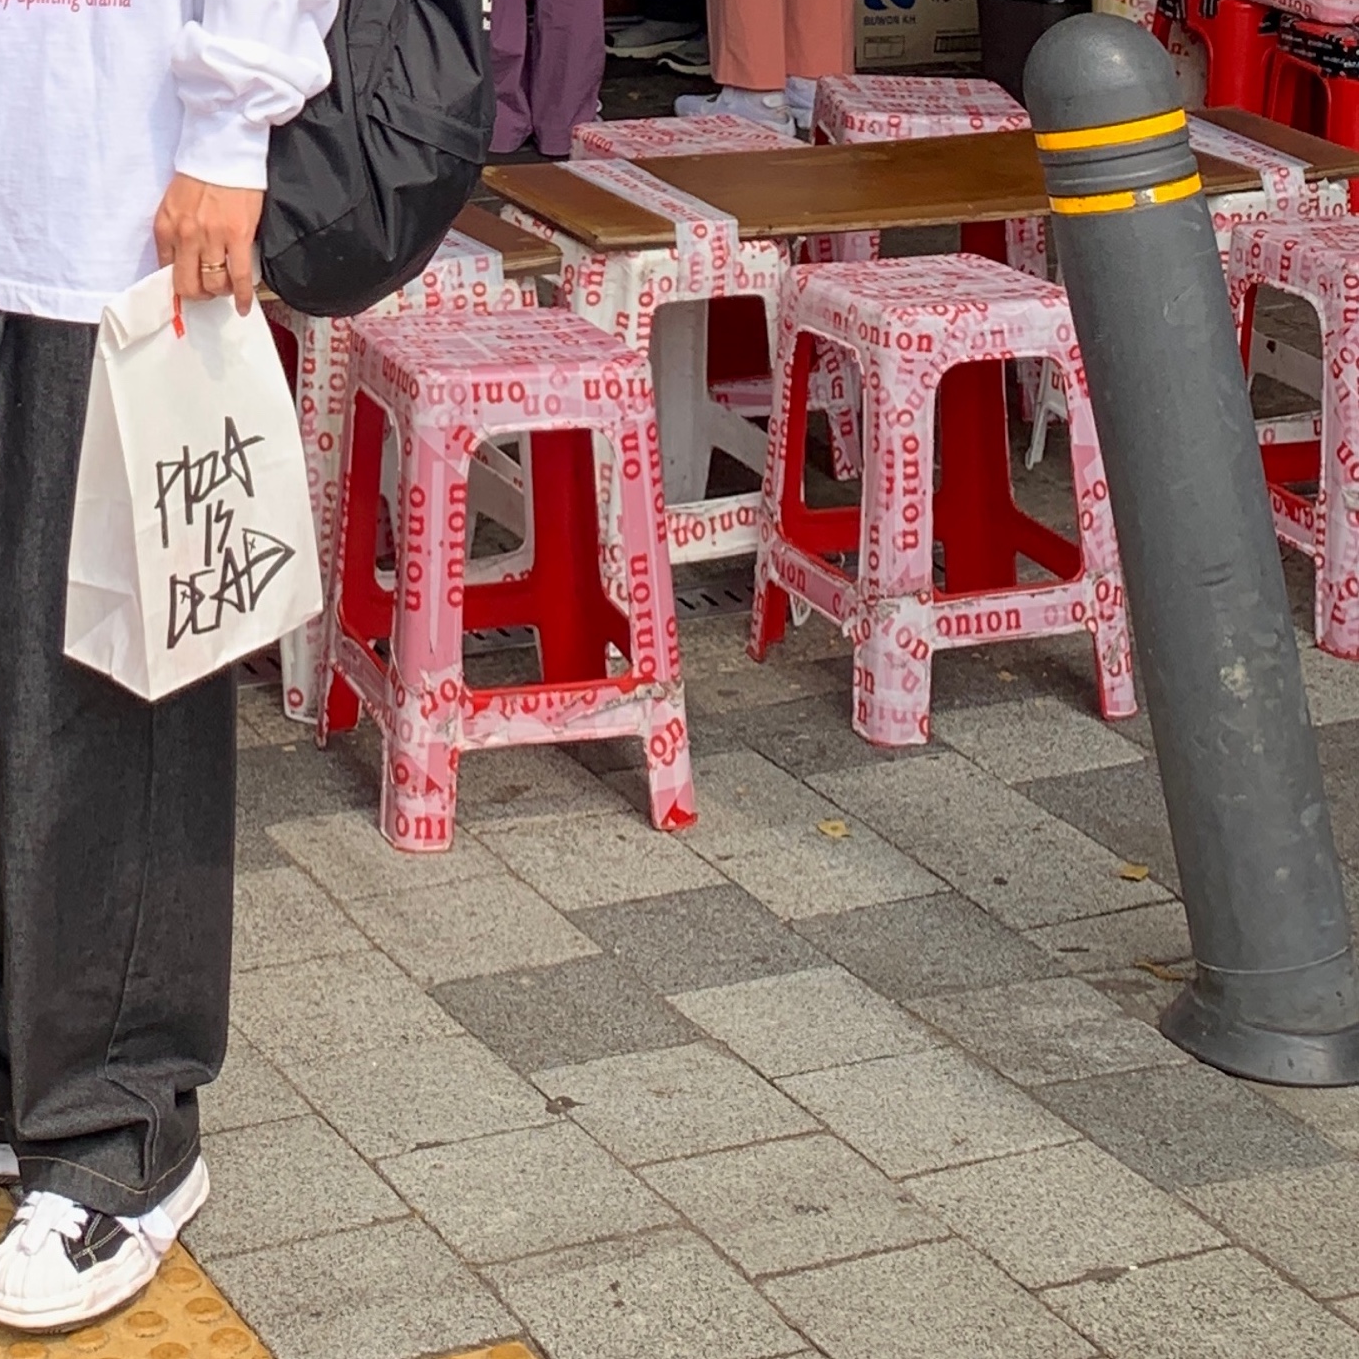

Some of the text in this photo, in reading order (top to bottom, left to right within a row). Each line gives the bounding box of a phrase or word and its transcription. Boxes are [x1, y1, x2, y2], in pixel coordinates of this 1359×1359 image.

[858, 320, 934, 353] onion
[204, 499, 235, 568] IS
[403, 483, 427, 613] onion
[446, 482, 467, 608] onion
[900, 433, 921, 553] onion
[167, 528, 297, 650] DEAD
[629, 552, 658, 678] onion
[936, 607, 1022, 637] onion
